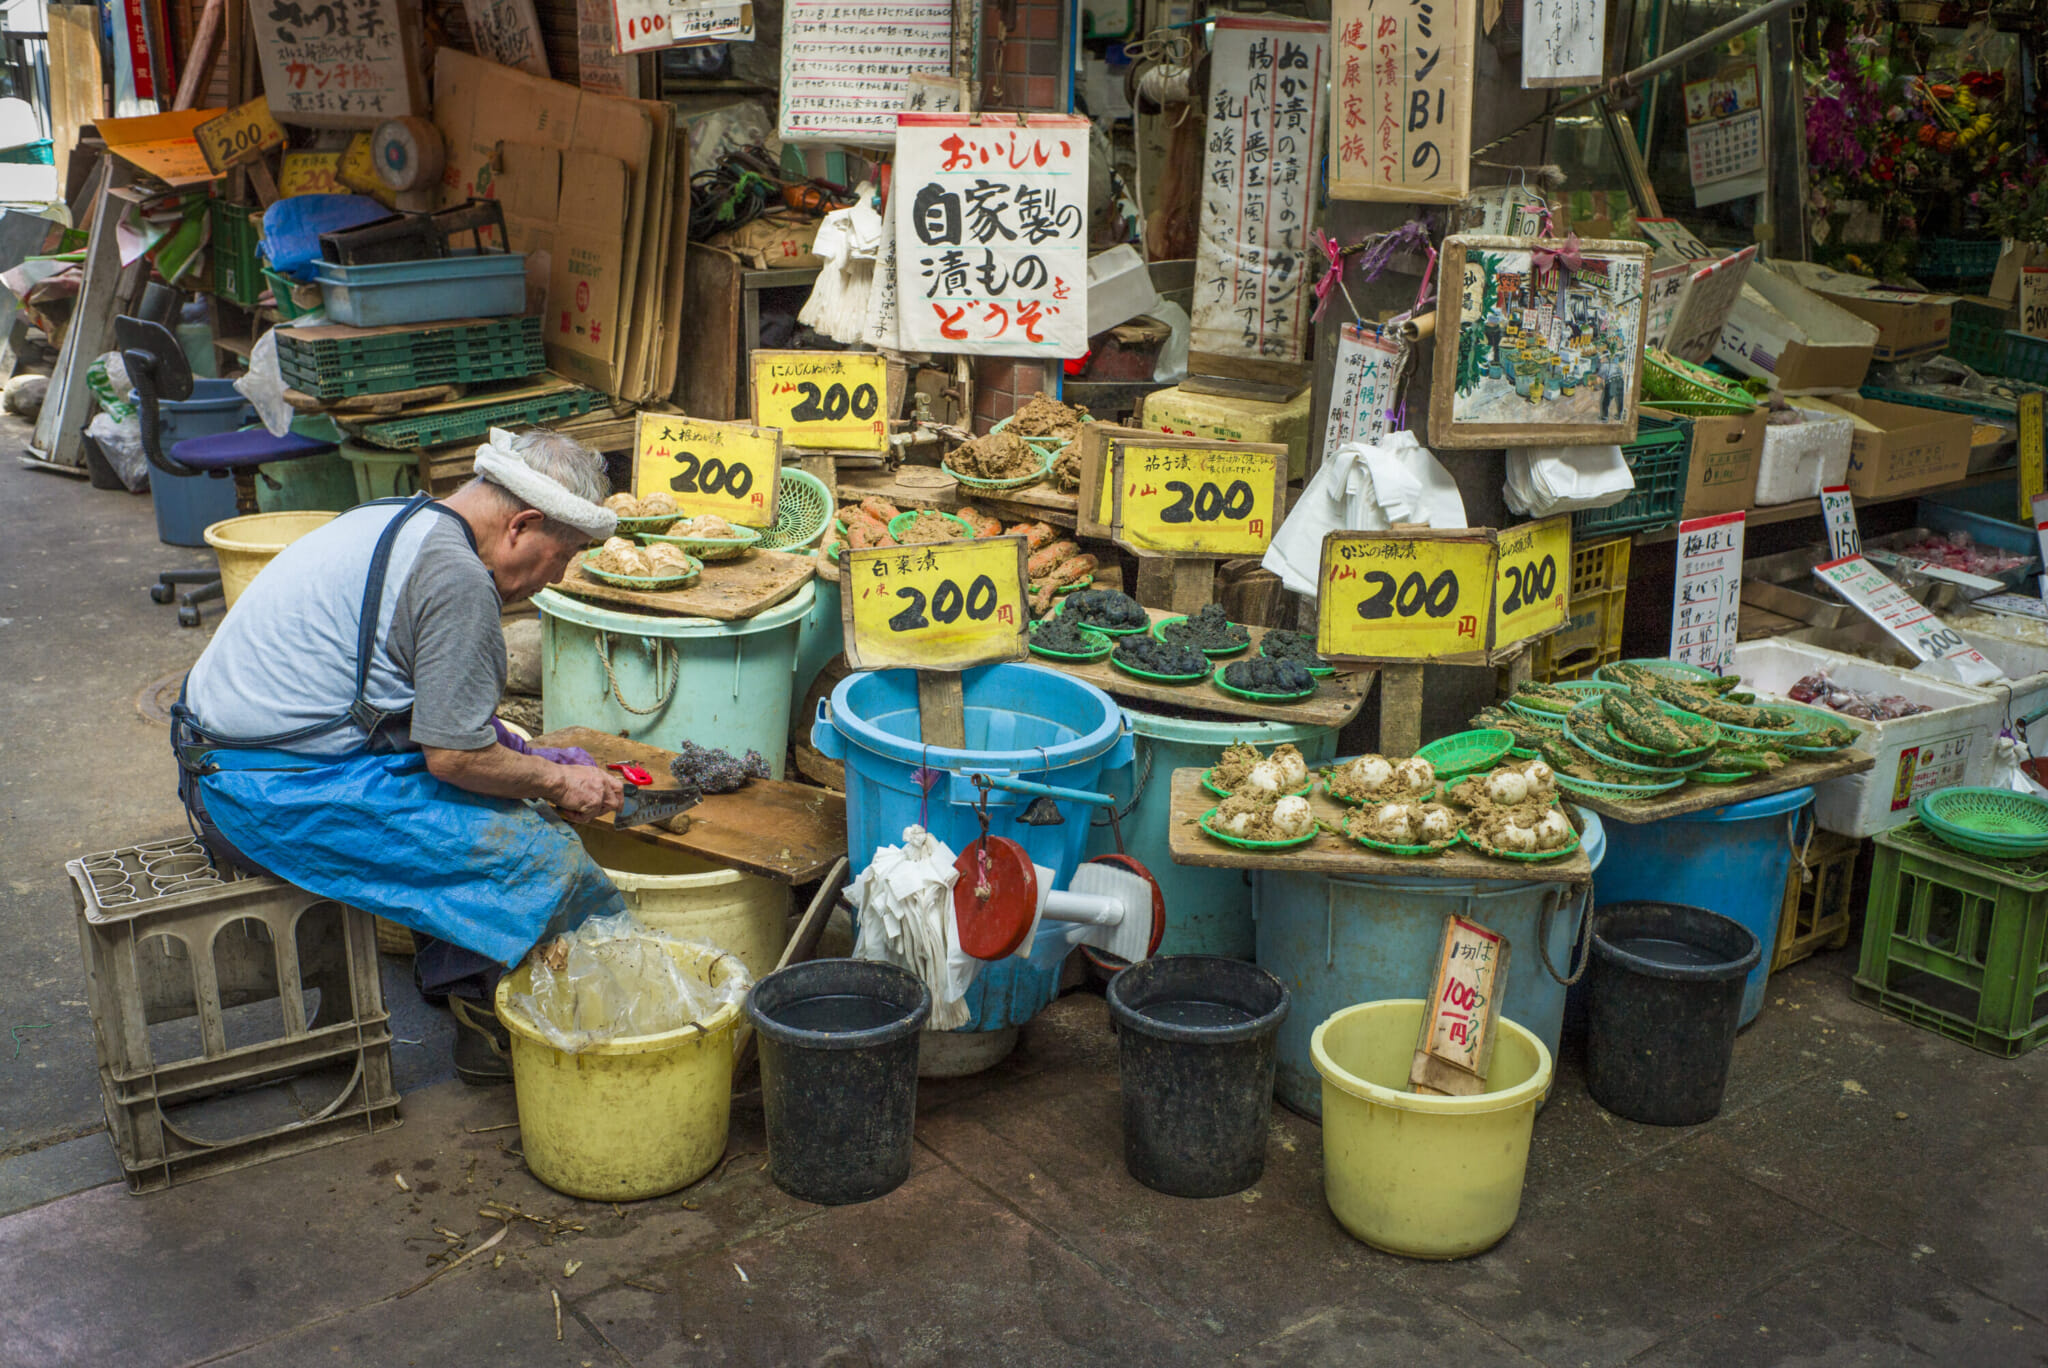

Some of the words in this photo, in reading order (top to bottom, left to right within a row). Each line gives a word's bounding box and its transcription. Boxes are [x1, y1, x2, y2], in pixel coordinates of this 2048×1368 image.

[629, 14, 665, 40] 100
[1340, 17, 1368, 167] 健康家族
[1407, 0, 1446, 182] ミンB1の
[217, 122, 262, 162] 200
[939, 130, 1071, 172] おいしい
[912, 178, 1083, 246] 自家製の
[931, 299, 1061, 343] どうぞ
[790, 381, 879, 422] 200
[872, 420, 885, 436] 円
[669, 451, 754, 499] 200
[750, 492, 764, 509] 円
[1159, 479, 1255, 524] 200
[1248, 518, 1264, 539] 円
[871, 549, 940, 578] 白菜漬
[1682, 529, 1736, 558] 梅ぼし
[1835, 528, 1861, 560] 150
[888, 573, 998, 632] 200
[996, 603, 1014, 625] 円
[1357, 569, 1460, 619] 200
[1457, 615, 1477, 639] 円
[1502, 553, 1557, 616] 200
[1554, 593, 1564, 611] 円
[1918, 627, 1963, 659] 200
[1442, 976, 1476, 1011] 100
[1449, 1021, 1468, 1046] 円
